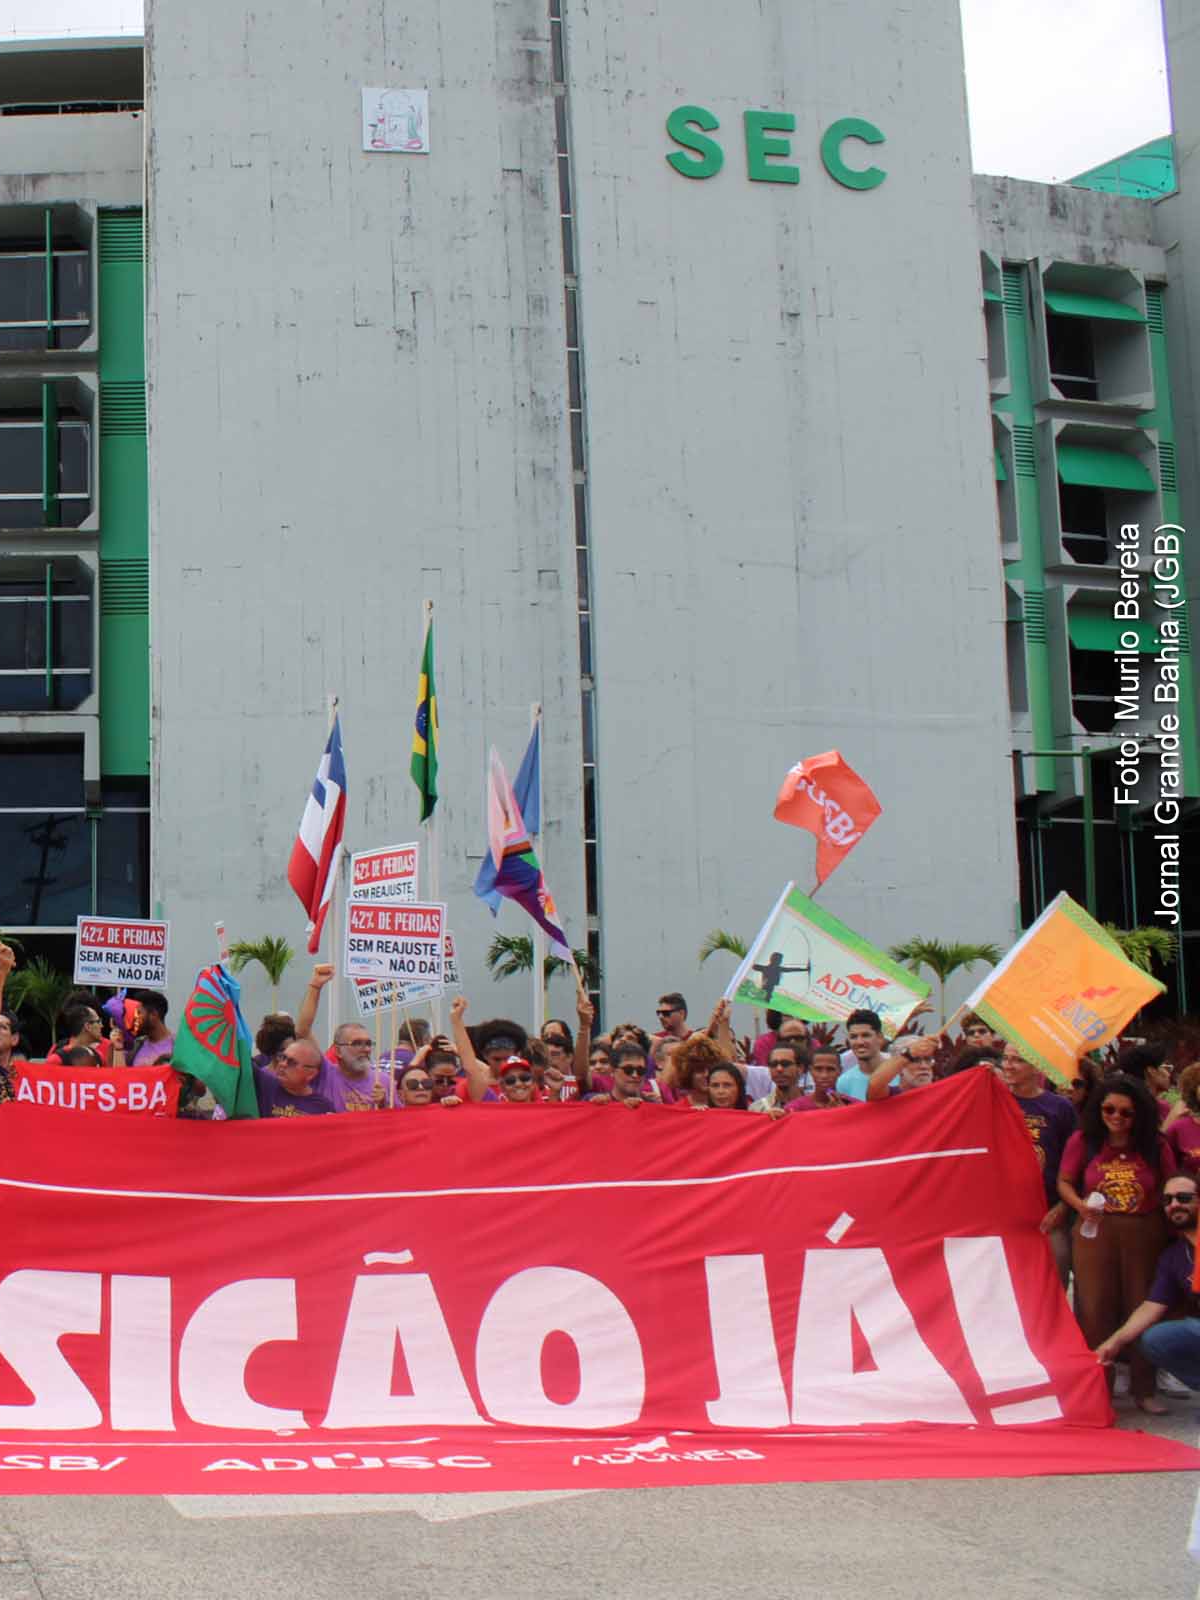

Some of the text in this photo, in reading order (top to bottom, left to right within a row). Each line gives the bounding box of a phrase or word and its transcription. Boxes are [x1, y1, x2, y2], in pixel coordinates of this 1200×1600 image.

[665, 104, 888, 192] SEC
[382, 854, 415, 876] PERDAS
[351, 911, 440, 933] 42% DE PERDAS
[82, 925, 164, 947] 42% DE PERDAS
[79, 950, 104, 963] SEM
[349, 938, 374, 952] SEM
[376, 940, 440, 959] REAJUSTE,
[389, 957, 416, 973] NÃO
[17, 1077, 167, 1112] ADUFS-BA
[704, 1211, 1065, 1430] JÁ!
[200, 1452, 493, 1471] ADUSC
